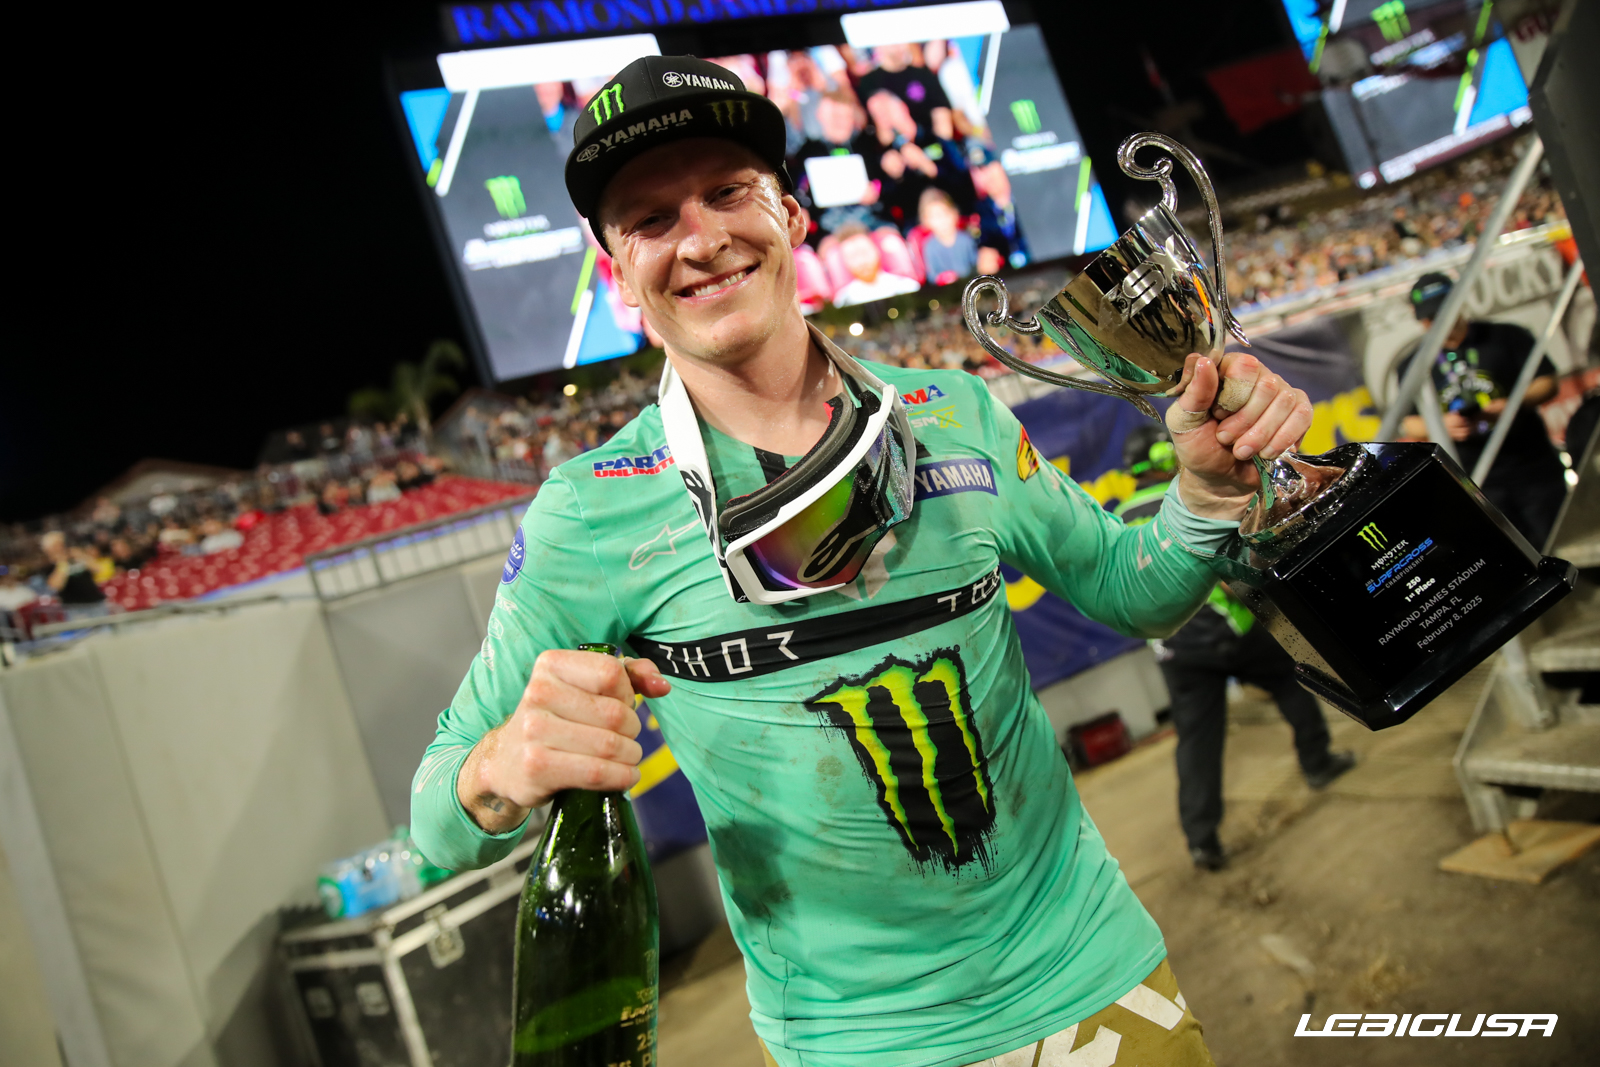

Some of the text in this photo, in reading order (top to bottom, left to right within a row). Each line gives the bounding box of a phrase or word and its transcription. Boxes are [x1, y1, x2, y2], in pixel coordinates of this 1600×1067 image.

[451, 0, 685, 44] RAYMOND
[681, 73, 736, 91] YAMAHA
[600, 109, 693, 148] YAMAHA
[914, 463, 994, 493] YAMAHA
[1366, 537, 1433, 594] SUPERCROSS
[1371, 539, 1409, 571] MONSTER
[1385, 555, 1425, 589] CHAMPIONSHIP
[1404, 577, 1436, 603] 1st Place
[1406, 576, 1421, 590] 250
[1378, 558, 1486, 646] RAYMOND JAMES STADIUM
[1419, 595, 1463, 630] TAMPA, FL
[1416, 595, 1483, 649] February 8, 2025
[658, 629, 799, 678] THOR
